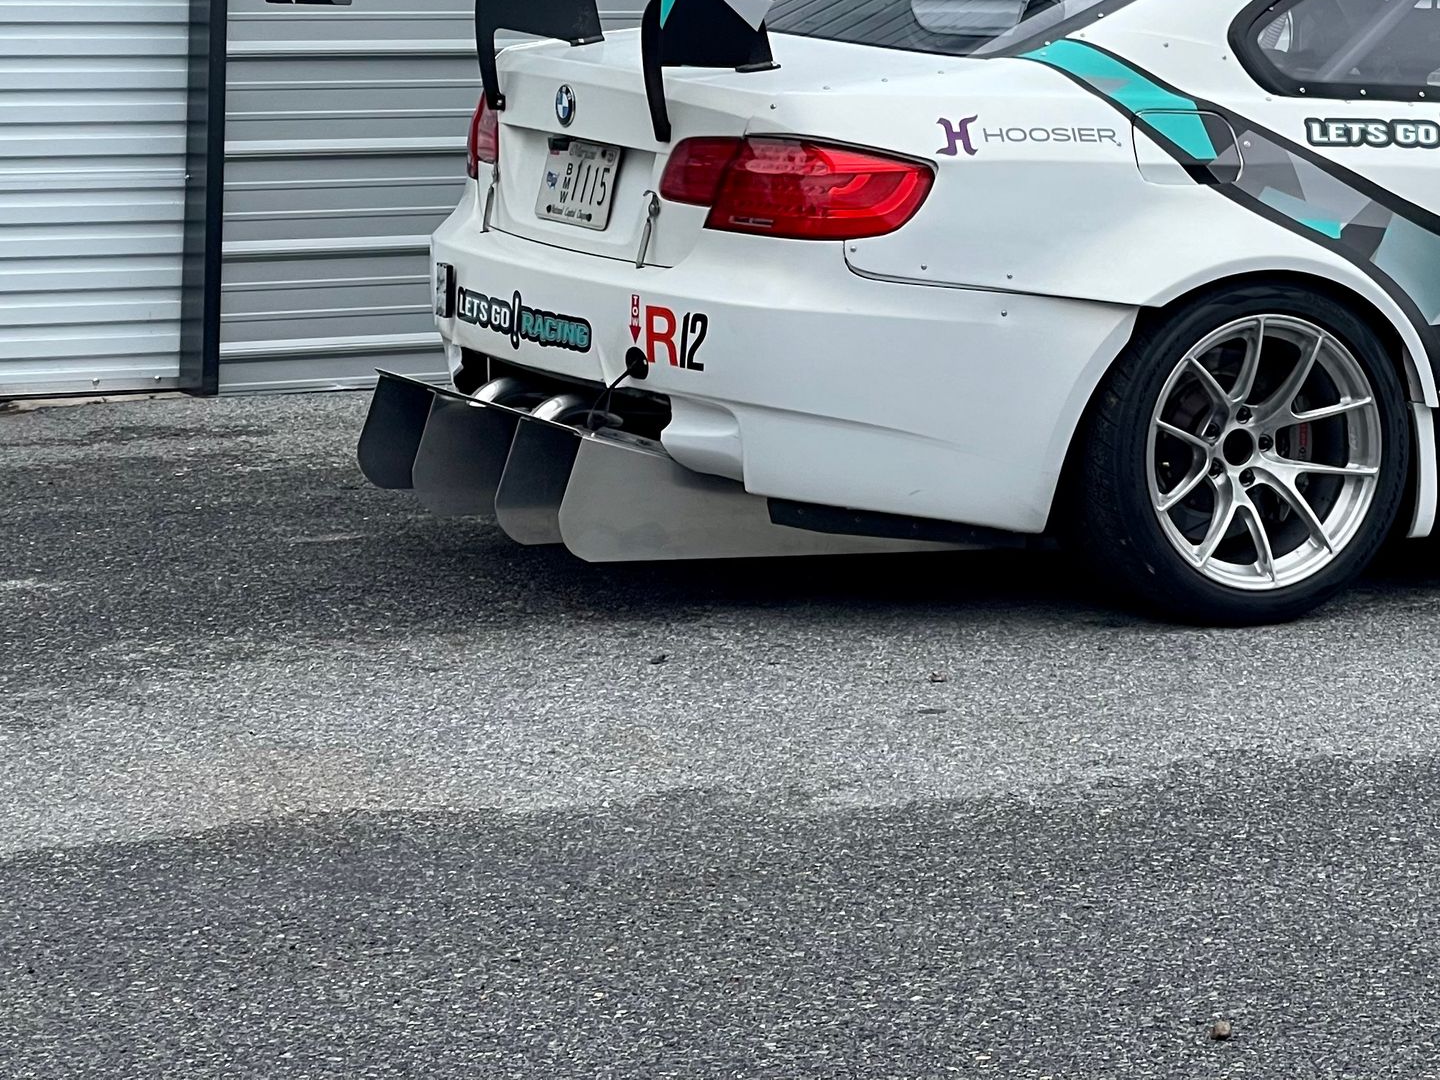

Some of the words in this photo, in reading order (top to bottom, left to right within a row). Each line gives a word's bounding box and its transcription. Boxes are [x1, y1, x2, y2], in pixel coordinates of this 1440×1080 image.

[983, 127, 1119, 144] HOOSIER
[1310, 121, 1389, 143] LETS
[571, 160, 610, 206] 1115
[458, 293, 488, 322] LETS
[521, 308, 590, 348] RACING
